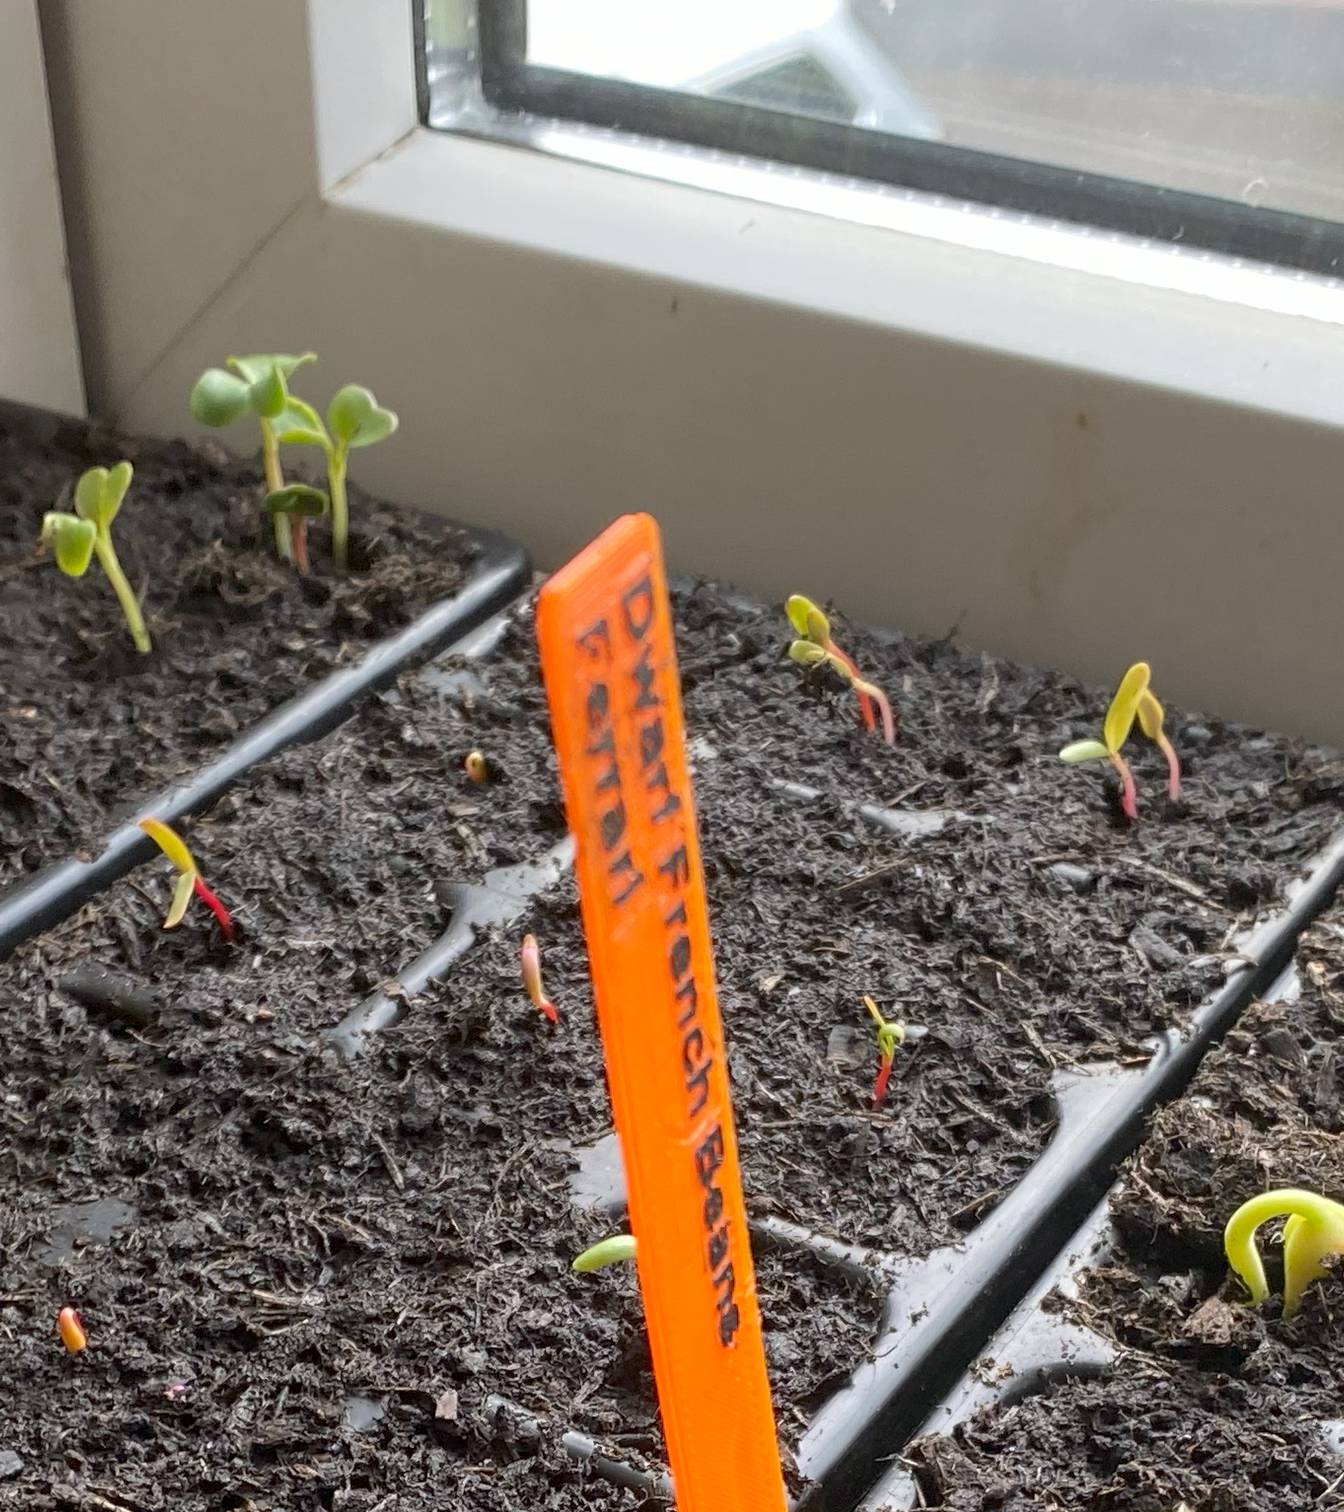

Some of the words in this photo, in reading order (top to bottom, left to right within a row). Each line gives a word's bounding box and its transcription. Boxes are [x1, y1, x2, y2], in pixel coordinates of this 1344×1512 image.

[575, 618, 645, 907] Ferrari
[622, 575, 682, 824] Dwarf
[659, 844, 713, 1118] French
[694, 1122, 740, 1349] Beans
